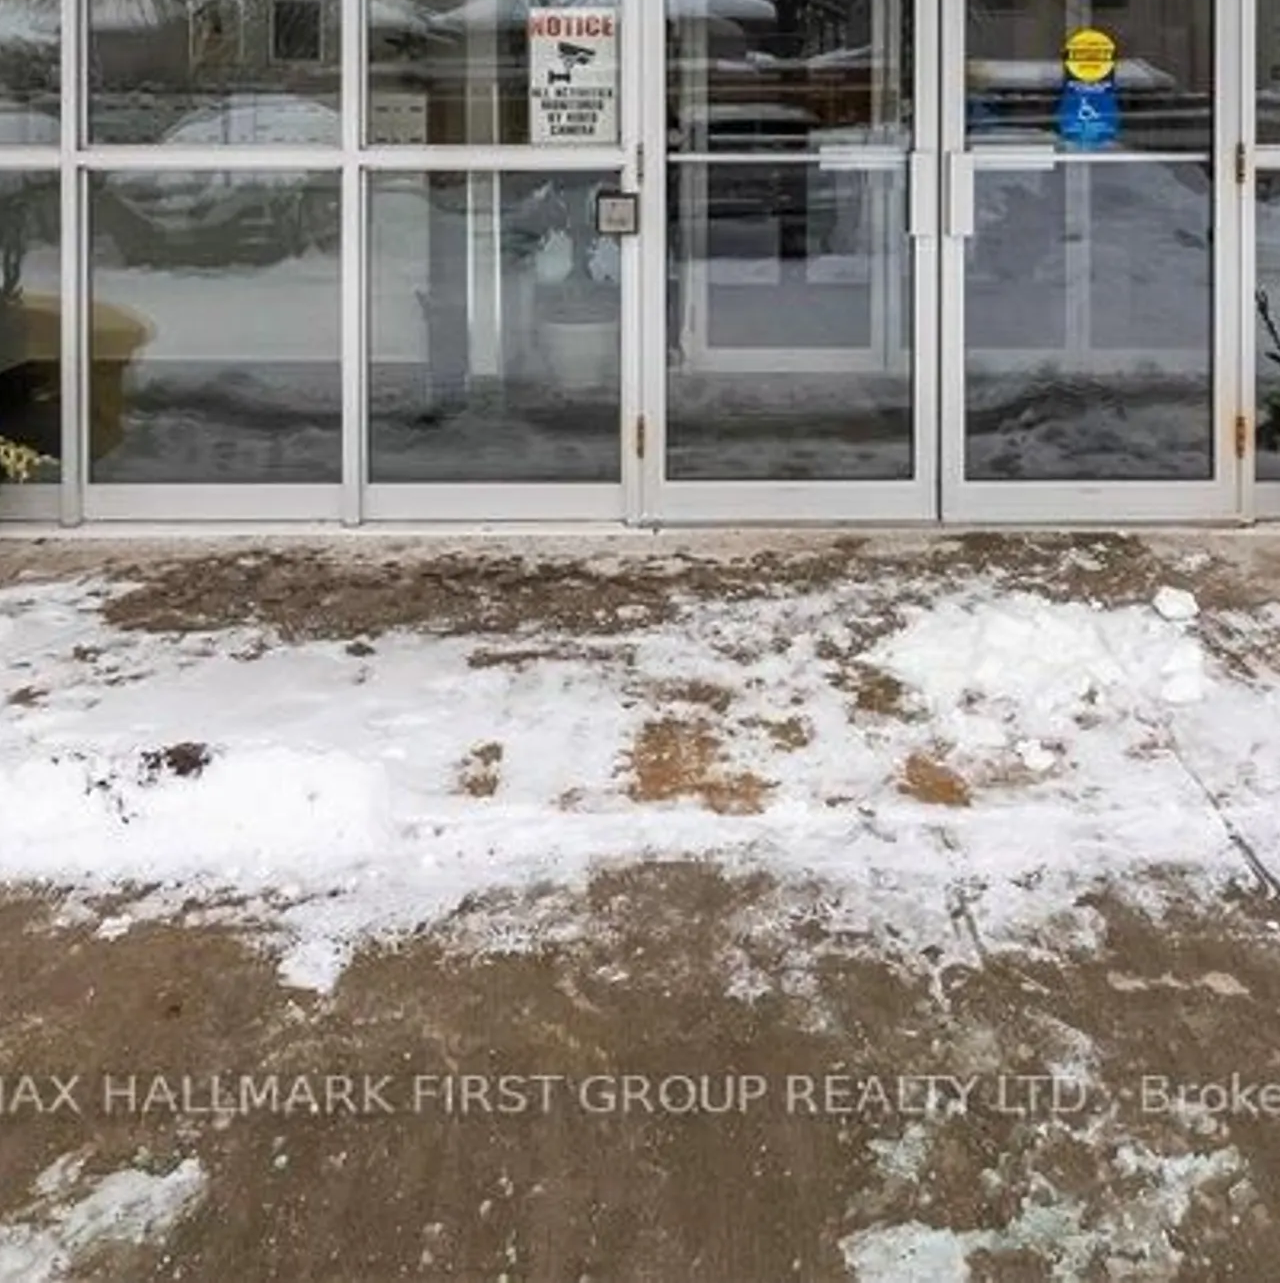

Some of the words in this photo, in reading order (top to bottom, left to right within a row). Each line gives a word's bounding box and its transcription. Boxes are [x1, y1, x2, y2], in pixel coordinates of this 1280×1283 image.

[529, 15, 613, 36] NOTICE
[547, 112, 562, 123] BY
[549, 125, 595, 136] CAMERA
